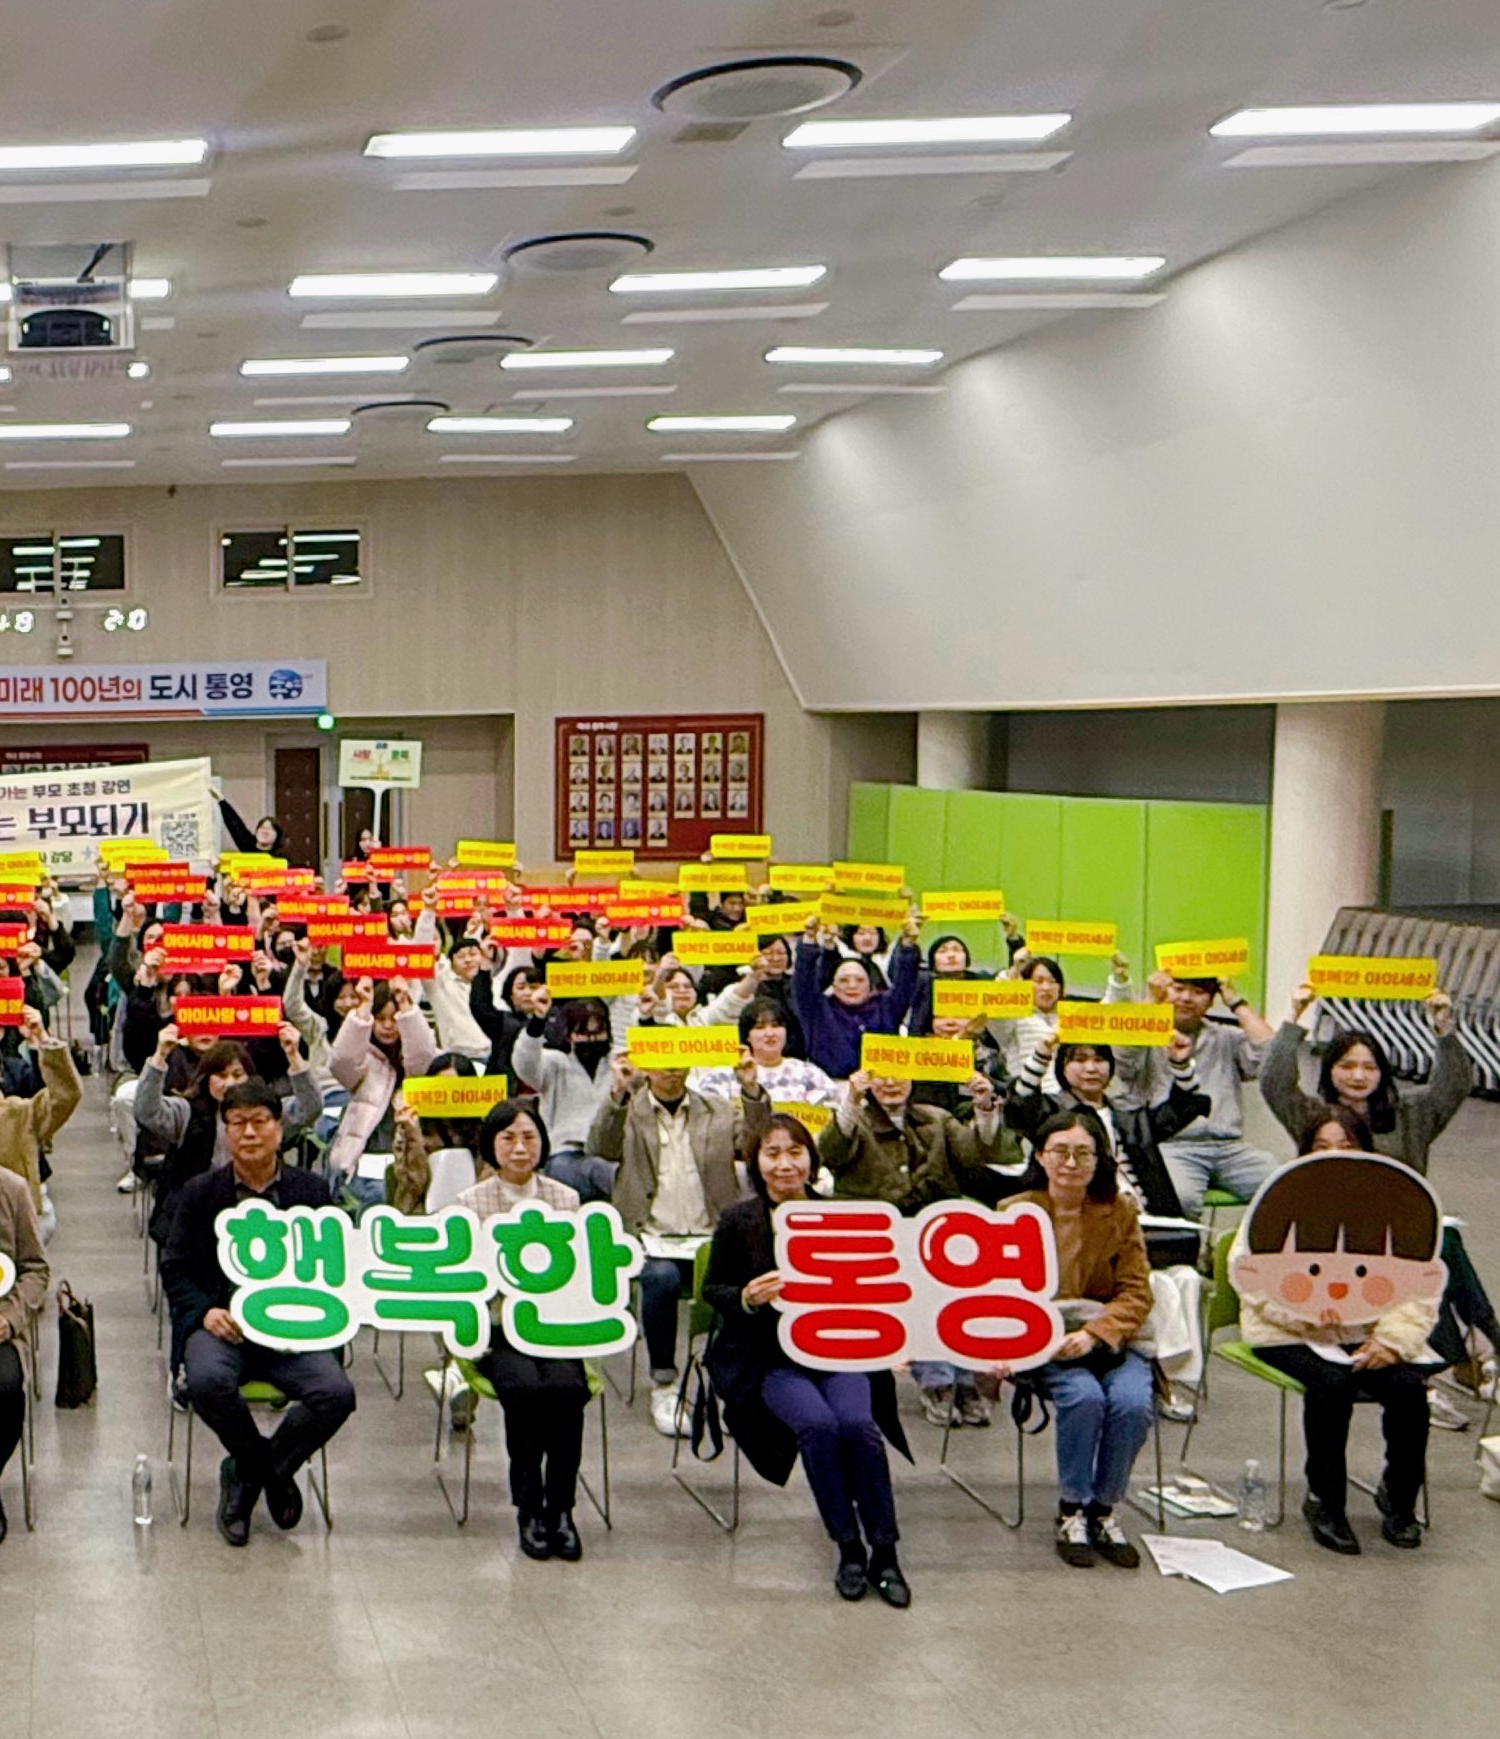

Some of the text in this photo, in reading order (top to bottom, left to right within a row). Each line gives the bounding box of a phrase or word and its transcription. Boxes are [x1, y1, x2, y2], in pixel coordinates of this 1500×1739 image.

[50, 675, 142, 704] 100년의
[149, 673, 198, 702] 도시
[205, 672, 254, 700] 통영
[32, 783, 61, 798] 부모
[67, 781, 95, 796] 초청
[101, 779, 131, 794] 강연
[28, 802, 149, 840] 부모되기
[1365, 969, 1431, 987] 아이세상
[679, 1039, 737, 1054] 아이세상
[225, 1207, 633, 1349] 행복한
[780, 1210, 1053, 1360] 통영
